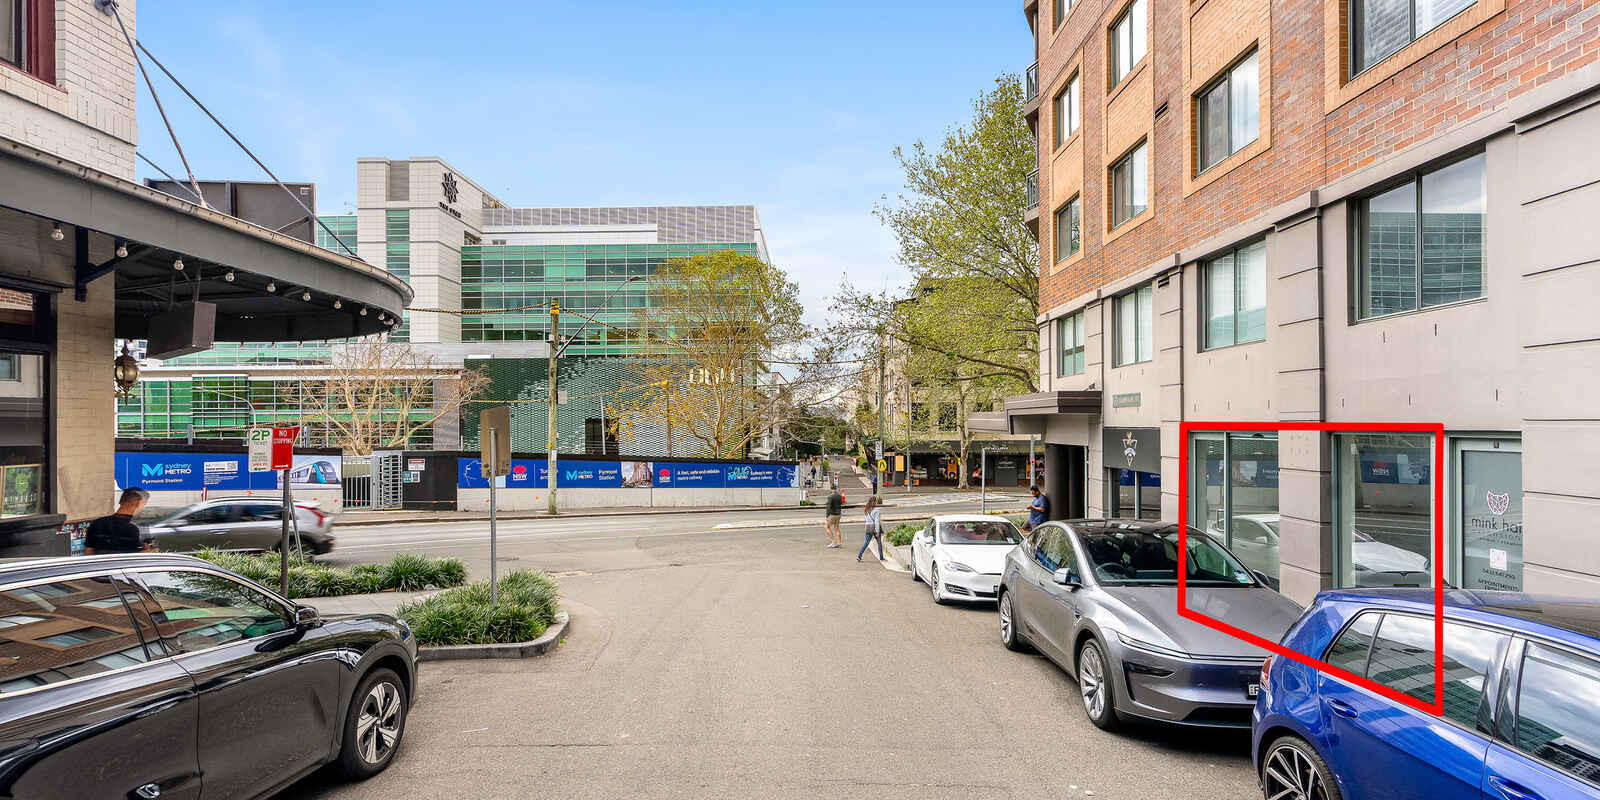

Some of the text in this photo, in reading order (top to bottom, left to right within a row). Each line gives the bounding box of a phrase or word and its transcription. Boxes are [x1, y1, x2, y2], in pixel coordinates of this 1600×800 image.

[251, 429, 270, 441] 2P
[164, 463, 192, 471] sydney
[512, 472, 527, 481] NSW
[1472, 517, 1498, 530] mink
